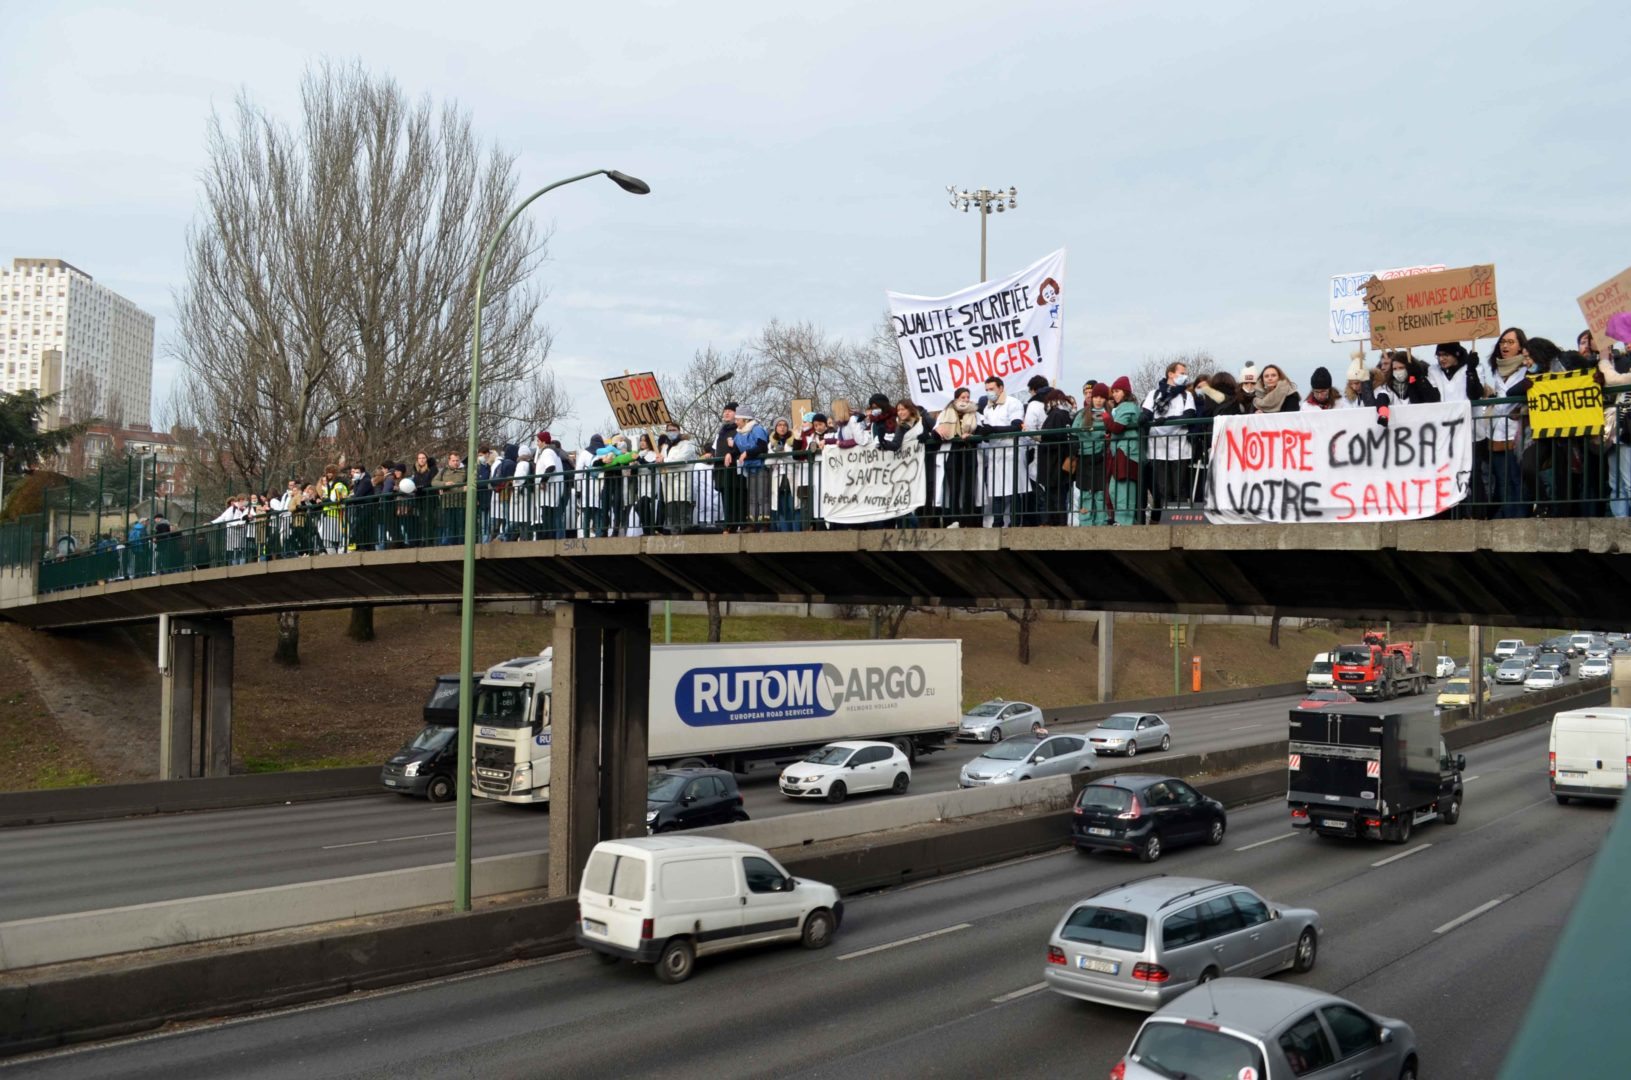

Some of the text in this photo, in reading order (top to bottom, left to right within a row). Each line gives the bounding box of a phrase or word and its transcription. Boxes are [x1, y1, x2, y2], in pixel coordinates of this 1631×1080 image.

[892, 283, 1034, 338] QUALITÉ SACRIFIÉE
[1369, 295, 1395, 313] SOINS
[1406, 287, 1448, 310] MAUVAISE
[1449, 278, 1492, 302] QUALITÉ
[1397, 307, 1445, 332] PÉRENNITÉ
[909, 316, 1024, 360] VOTRE SANTÉ
[606, 380, 630, 403] PAS
[916, 363, 944, 393] EN
[1226, 418, 1464, 472] NOTRE COMBAT
[828, 454, 844, 470] ON
[845, 463, 891, 486] SANTÉ
[1227, 463, 1451, 521] VOTRE SANTÉ
[693, 669, 813, 714] RUTOM
[729, 708, 814, 720] EUROPEAN ROAD SERVICES
